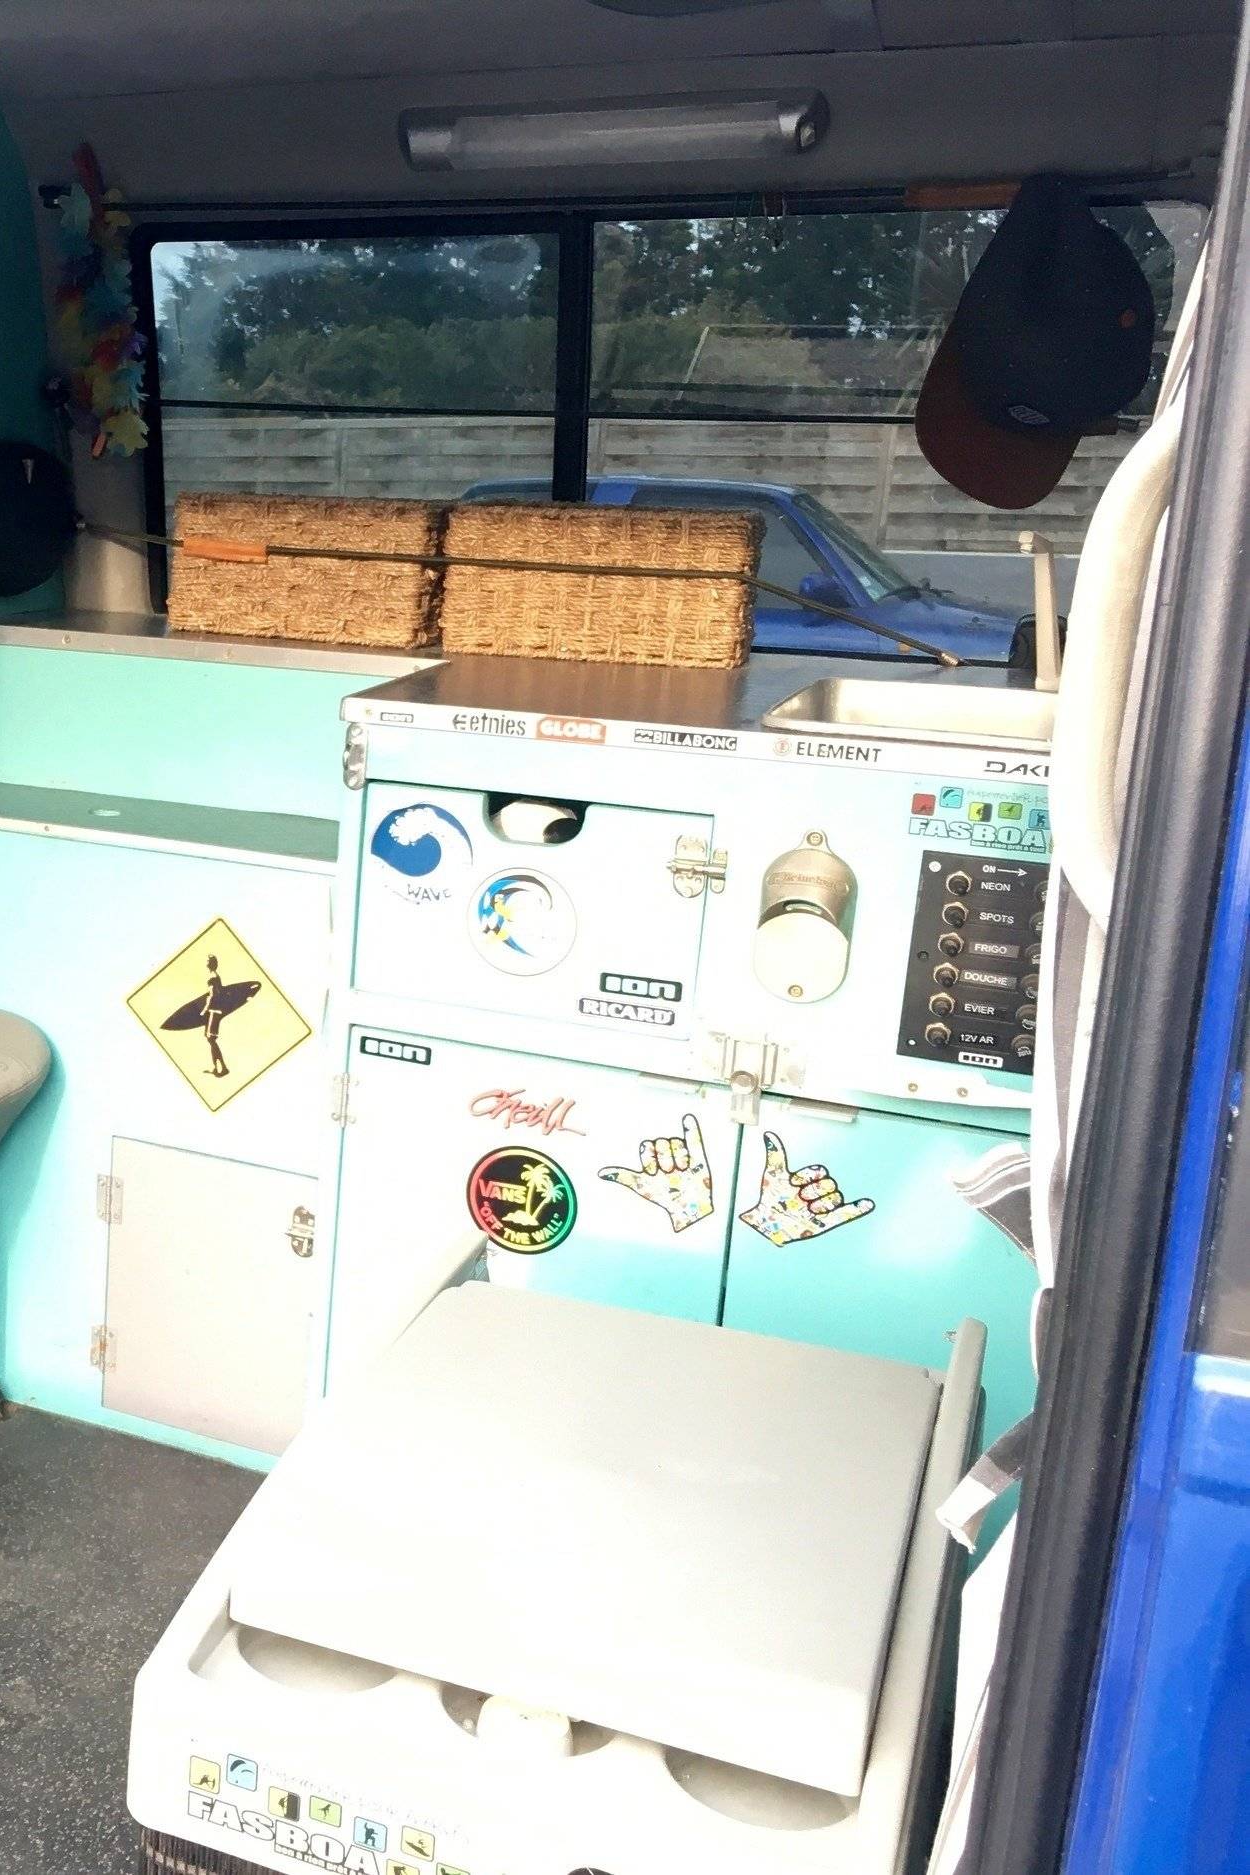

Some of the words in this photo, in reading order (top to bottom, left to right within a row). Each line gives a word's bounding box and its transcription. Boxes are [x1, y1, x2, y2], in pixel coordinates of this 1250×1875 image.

[469, 713, 526, 737] etnies
[539, 717, 606, 740] GLOBE
[652, 730, 738, 751] BILLABONG
[796, 741, 882, 763] ELEMENT
[982, 864, 997, 874] ON
[407, 884, 452, 901] WAVE
[980, 881, 1011, 892] NEON
[979, 911, 1015, 925] SPOTS
[974, 943, 1008, 955] FRIGO
[963, 971, 1009, 986] DOUCHE
[581, 998, 672, 1025] RICARD
[964, 1003, 996, 1015] EVIER
[960, 1033, 978, 1043] 12V
[979, 1035, 995, 1045] AR
[478, 1179, 527, 1205] VANS
[503, 1227, 531, 1245] THE
